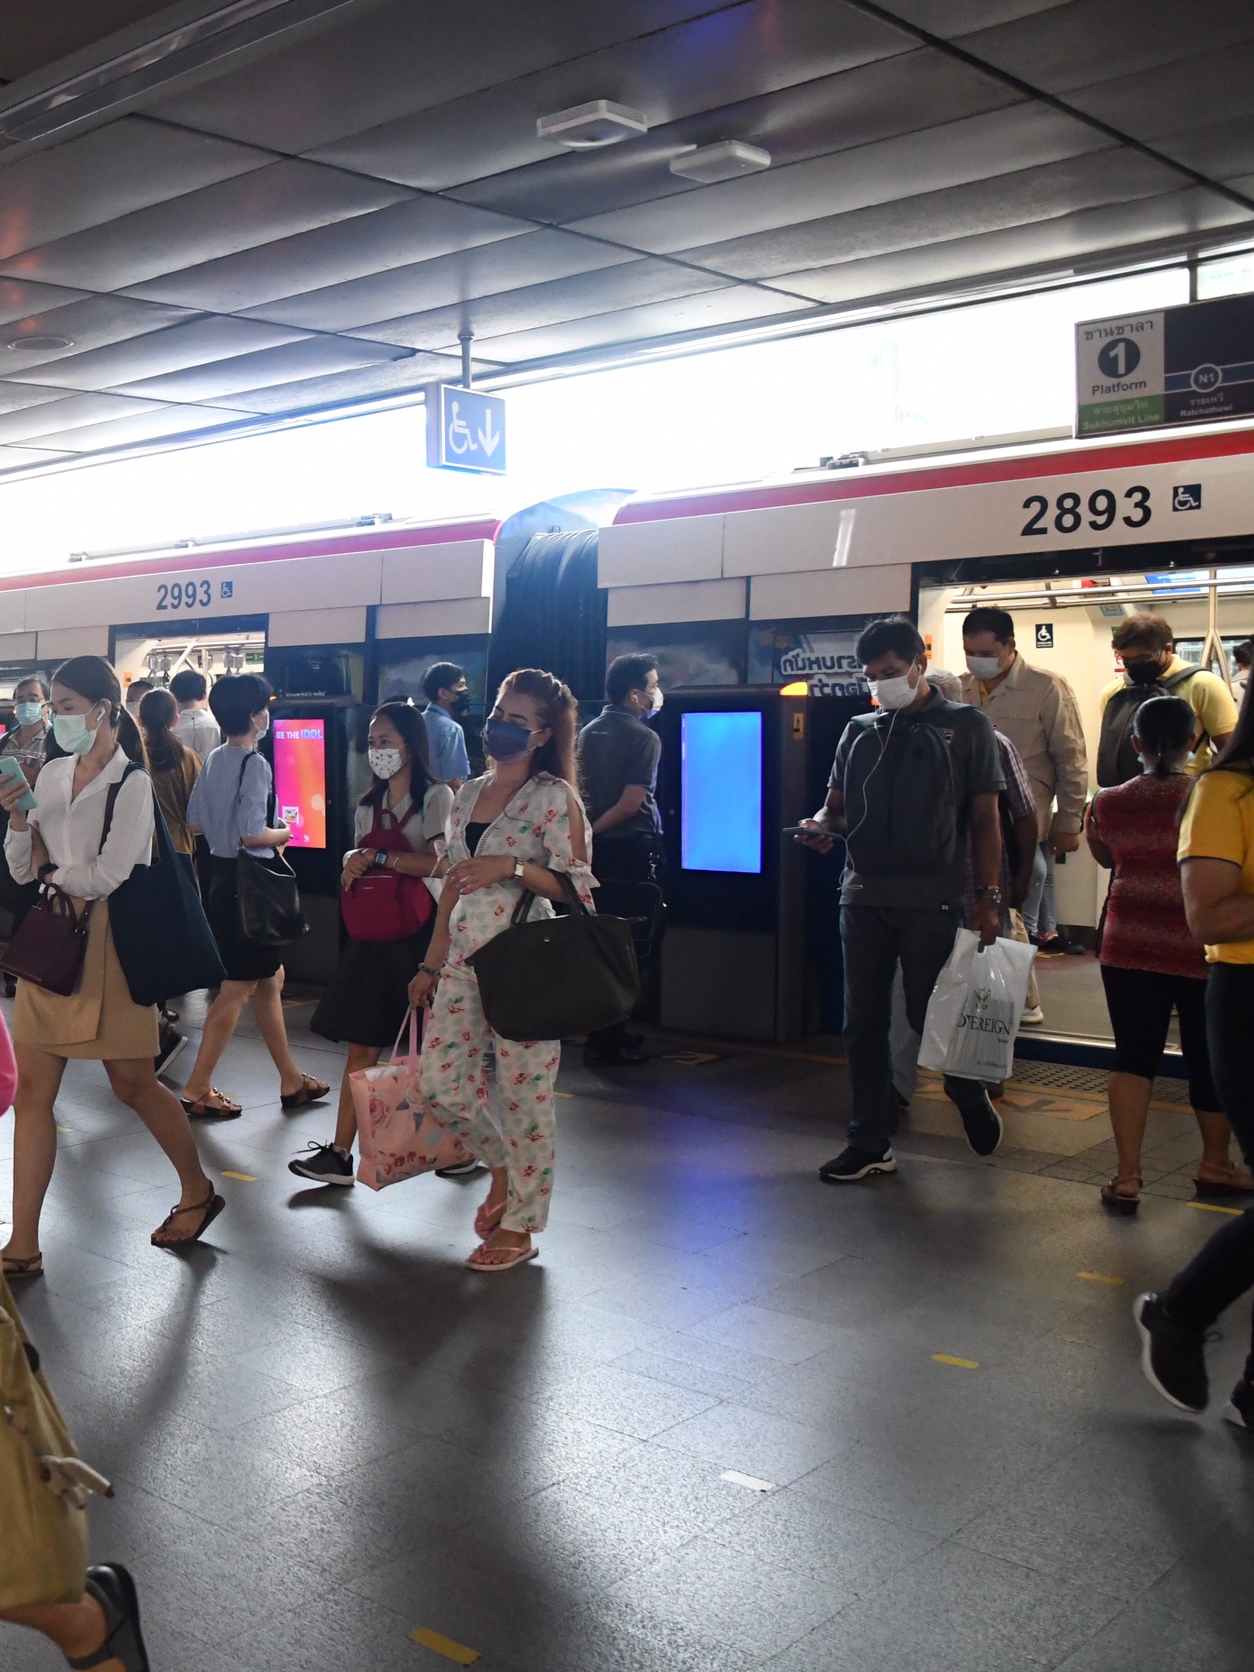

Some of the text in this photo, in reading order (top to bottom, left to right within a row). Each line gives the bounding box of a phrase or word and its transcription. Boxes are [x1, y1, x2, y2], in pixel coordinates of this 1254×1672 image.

[1084, 320, 1154, 341] ชานชาลา
[1109, 342, 1126, 375] 1
[1198, 373, 1214, 384] N1
[1092, 380, 1147, 395] Platform
[1180, 404, 1233, 417] Ratchathewi
[1083, 414, 1160, 430] Sukhumvit Line
[1020, 485, 1152, 536] 2893
[156, 580, 211, 610] 2993
[276, 729, 323, 739] BE THE IDOL
